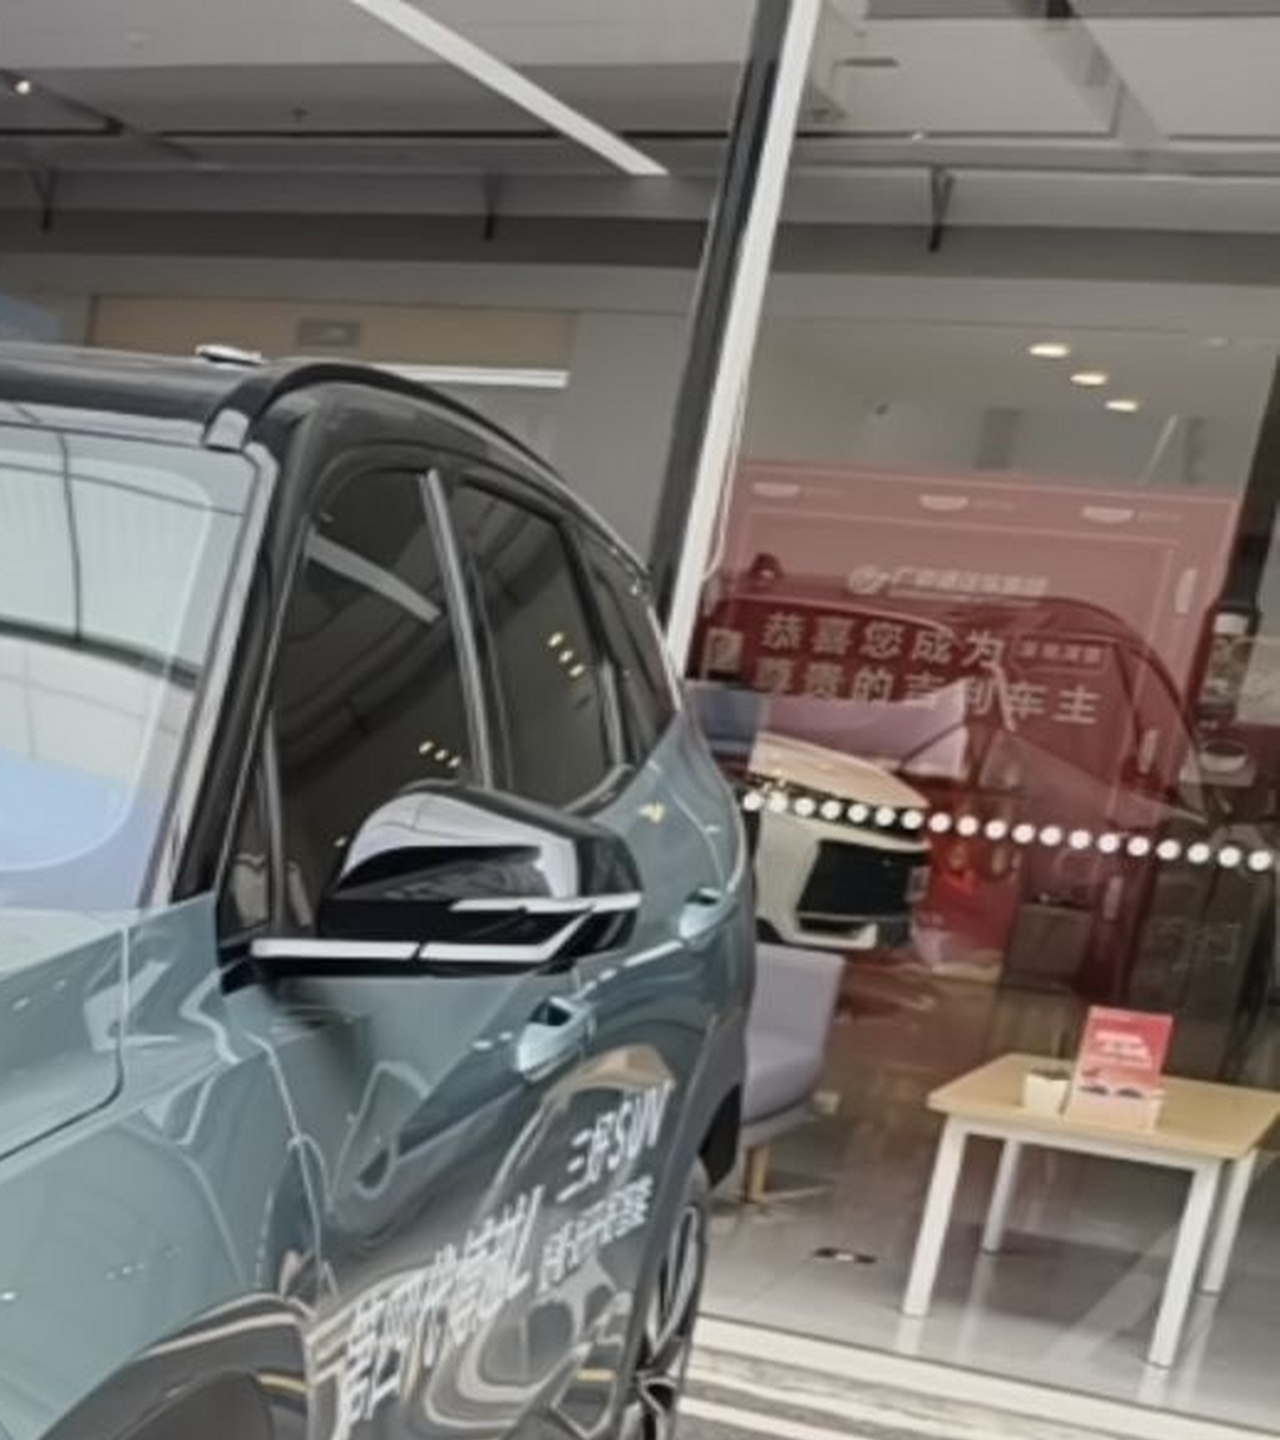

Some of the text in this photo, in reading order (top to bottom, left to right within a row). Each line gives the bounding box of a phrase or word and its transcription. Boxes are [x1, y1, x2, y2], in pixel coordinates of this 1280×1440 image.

[761, 611, 1007, 668] 恭喜您成为
